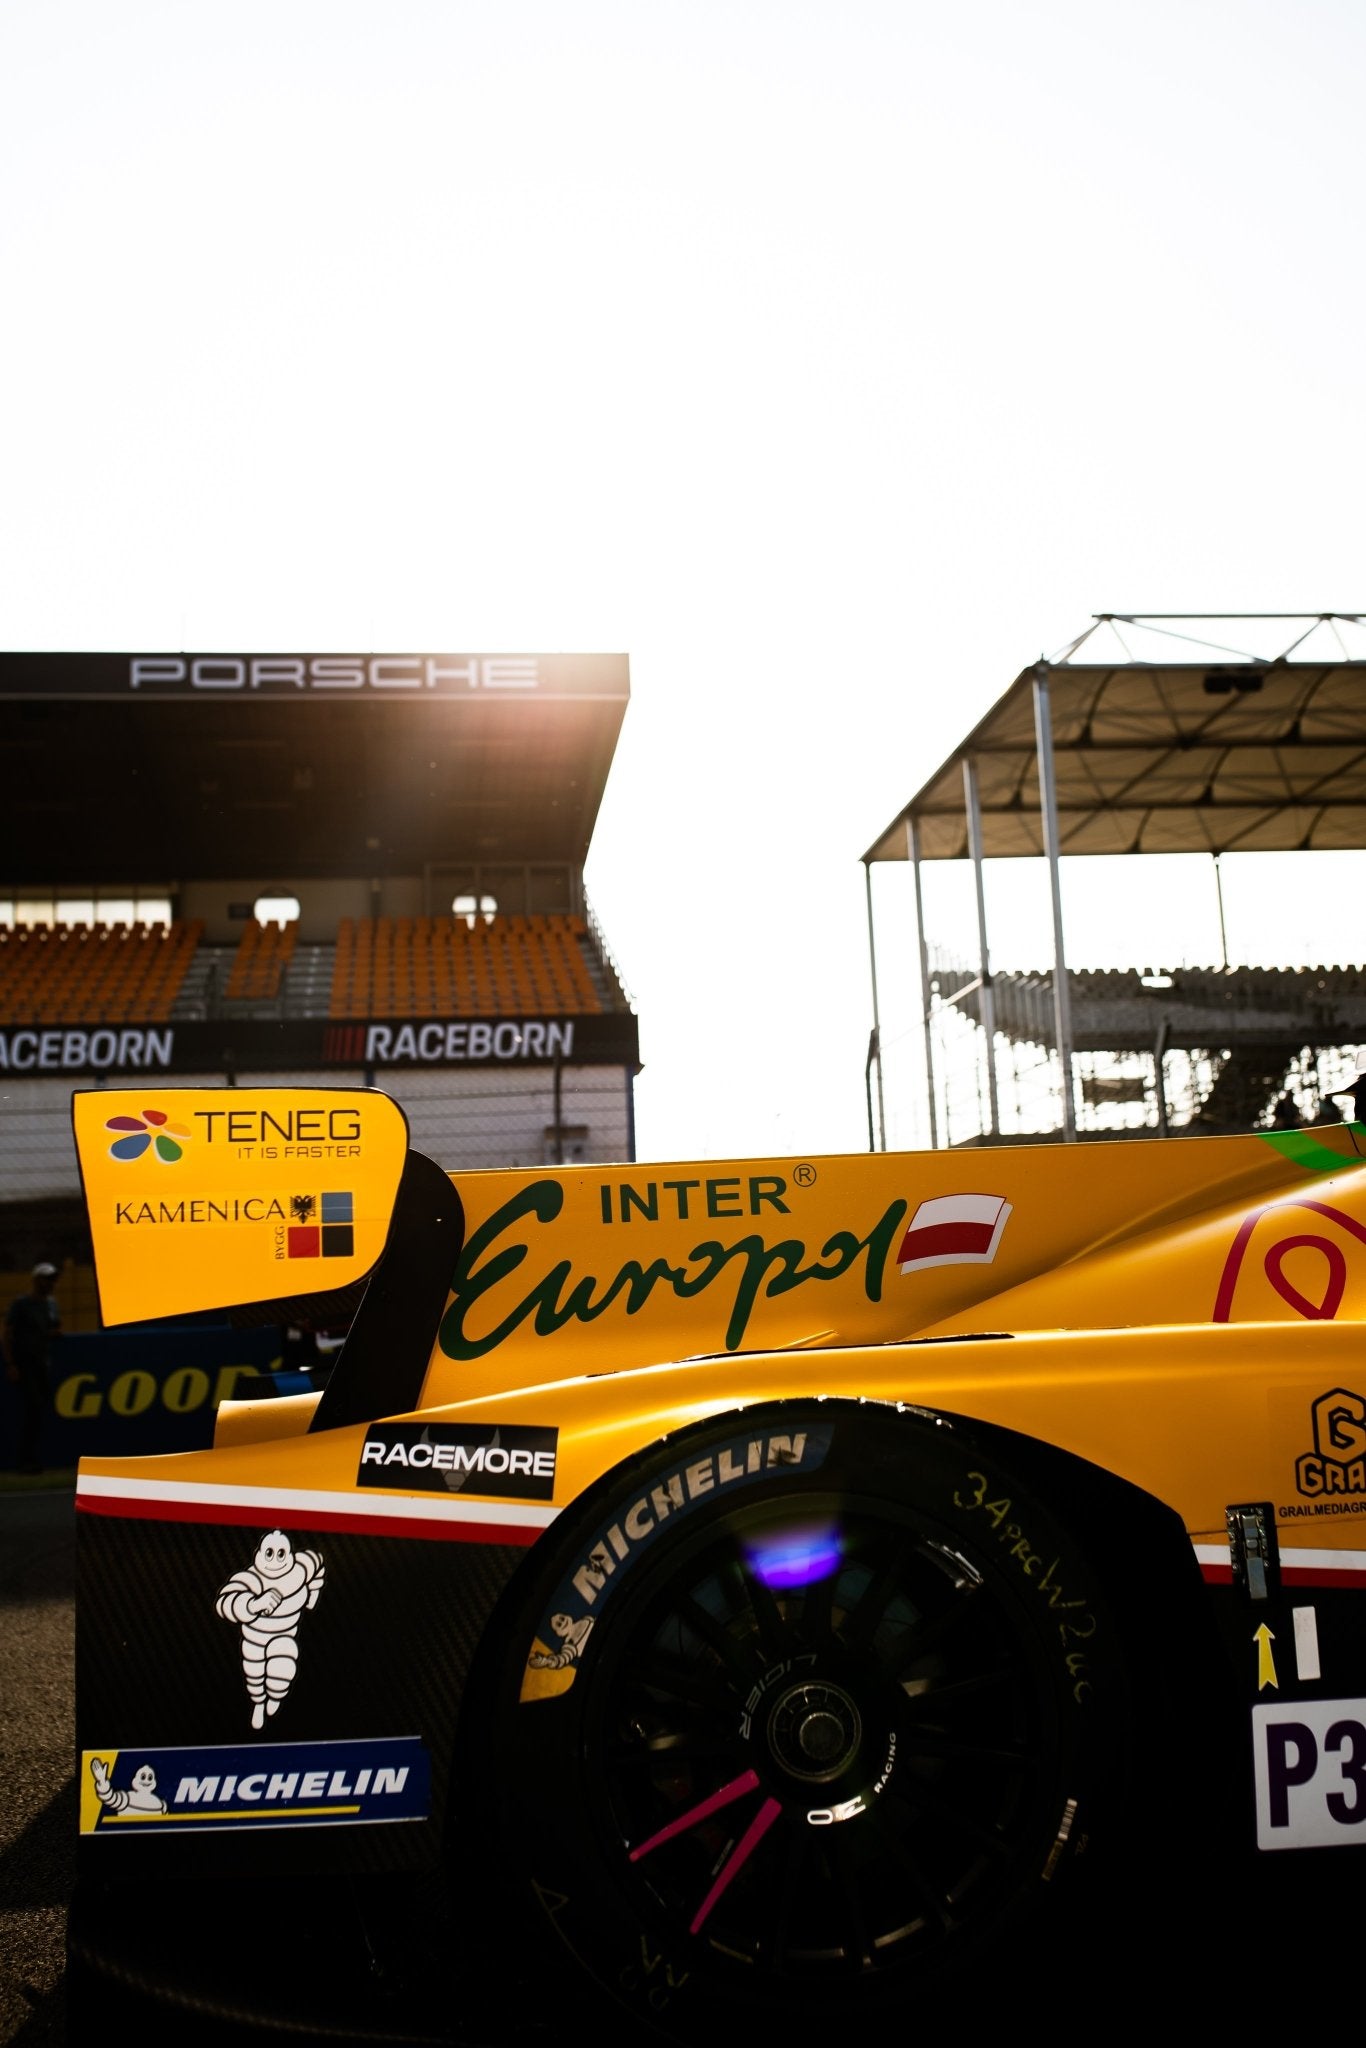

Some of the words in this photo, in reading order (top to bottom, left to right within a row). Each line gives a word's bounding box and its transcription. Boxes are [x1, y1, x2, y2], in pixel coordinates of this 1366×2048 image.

[130, 658, 539, 688] PORSCHE
[365, 1022, 575, 1061] RACEBORN
[194, 1109, 361, 1143] TENEG
[238, 1148, 254, 1160] IT
[261, 1147, 278, 1159] IS
[285, 1146, 361, 1158] FASTER
[116, 1199, 286, 1225] KAMENICA
[274, 1226, 285, 1260] BYGG
[438, 1179, 908, 1361] Europol
[361, 1442, 556, 1477] RACEMORE
[572, 1433, 807, 1605] MICHELIN
[873, 1731, 897, 1794] RACING
[174, 1767, 410, 1804] MICHELIN
